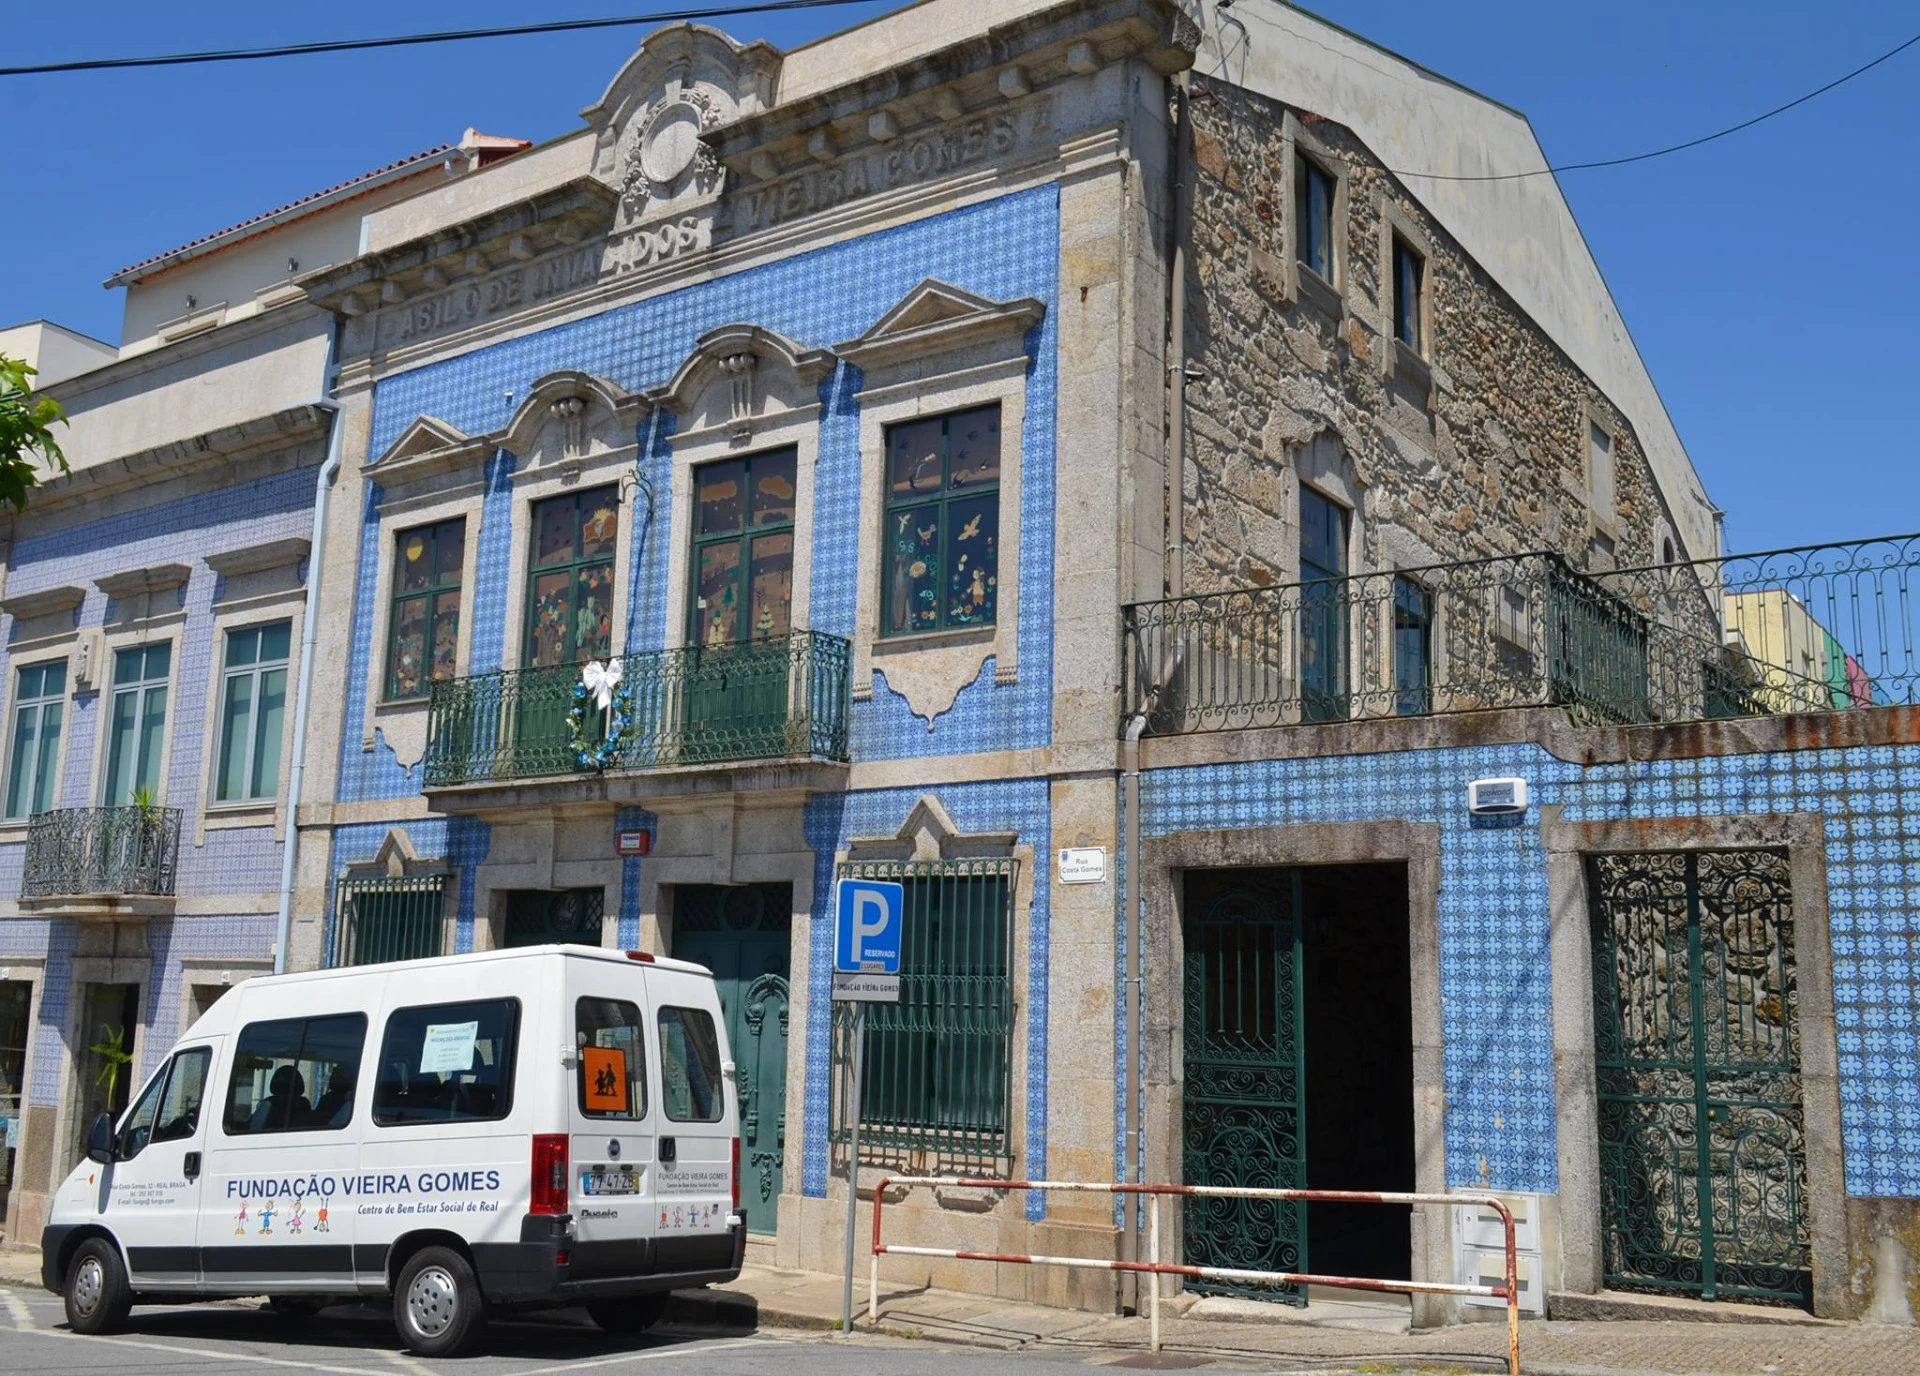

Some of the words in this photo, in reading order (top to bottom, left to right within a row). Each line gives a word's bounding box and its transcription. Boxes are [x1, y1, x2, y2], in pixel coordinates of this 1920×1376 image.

[400, 283, 481, 340] ASILO
[487, 274, 523, 313] DE
[744, 160, 869, 228] VIEIRA
[883, 117, 1017, 184] GOMES
[1061, 866, 1079, 874] Costa
[1080, 865, 1102, 873] Gomes
[851, 889, 890, 962] P
[864, 948, 896, 959] RESERVADO
[658, 1171, 690, 1181] FUNDAÇÃO
[709, 1171, 728, 1181] GOMES
[227, 1173, 336, 1201] FUNDAÇÃO
[342, 1174, 412, 1196] VIEIRA
[418, 1170, 500, 1193] GOMES
[358, 1204, 383, 1215] Centro
[385, 1204, 395, 1214] de
[397, 1203, 414, 1214] Bem
[417, 1203, 437, 1213] Estar
[440, 1201, 464, 1213] Social
[467, 1201, 477, 1212] de
[480, 1201, 498, 1212] Real
